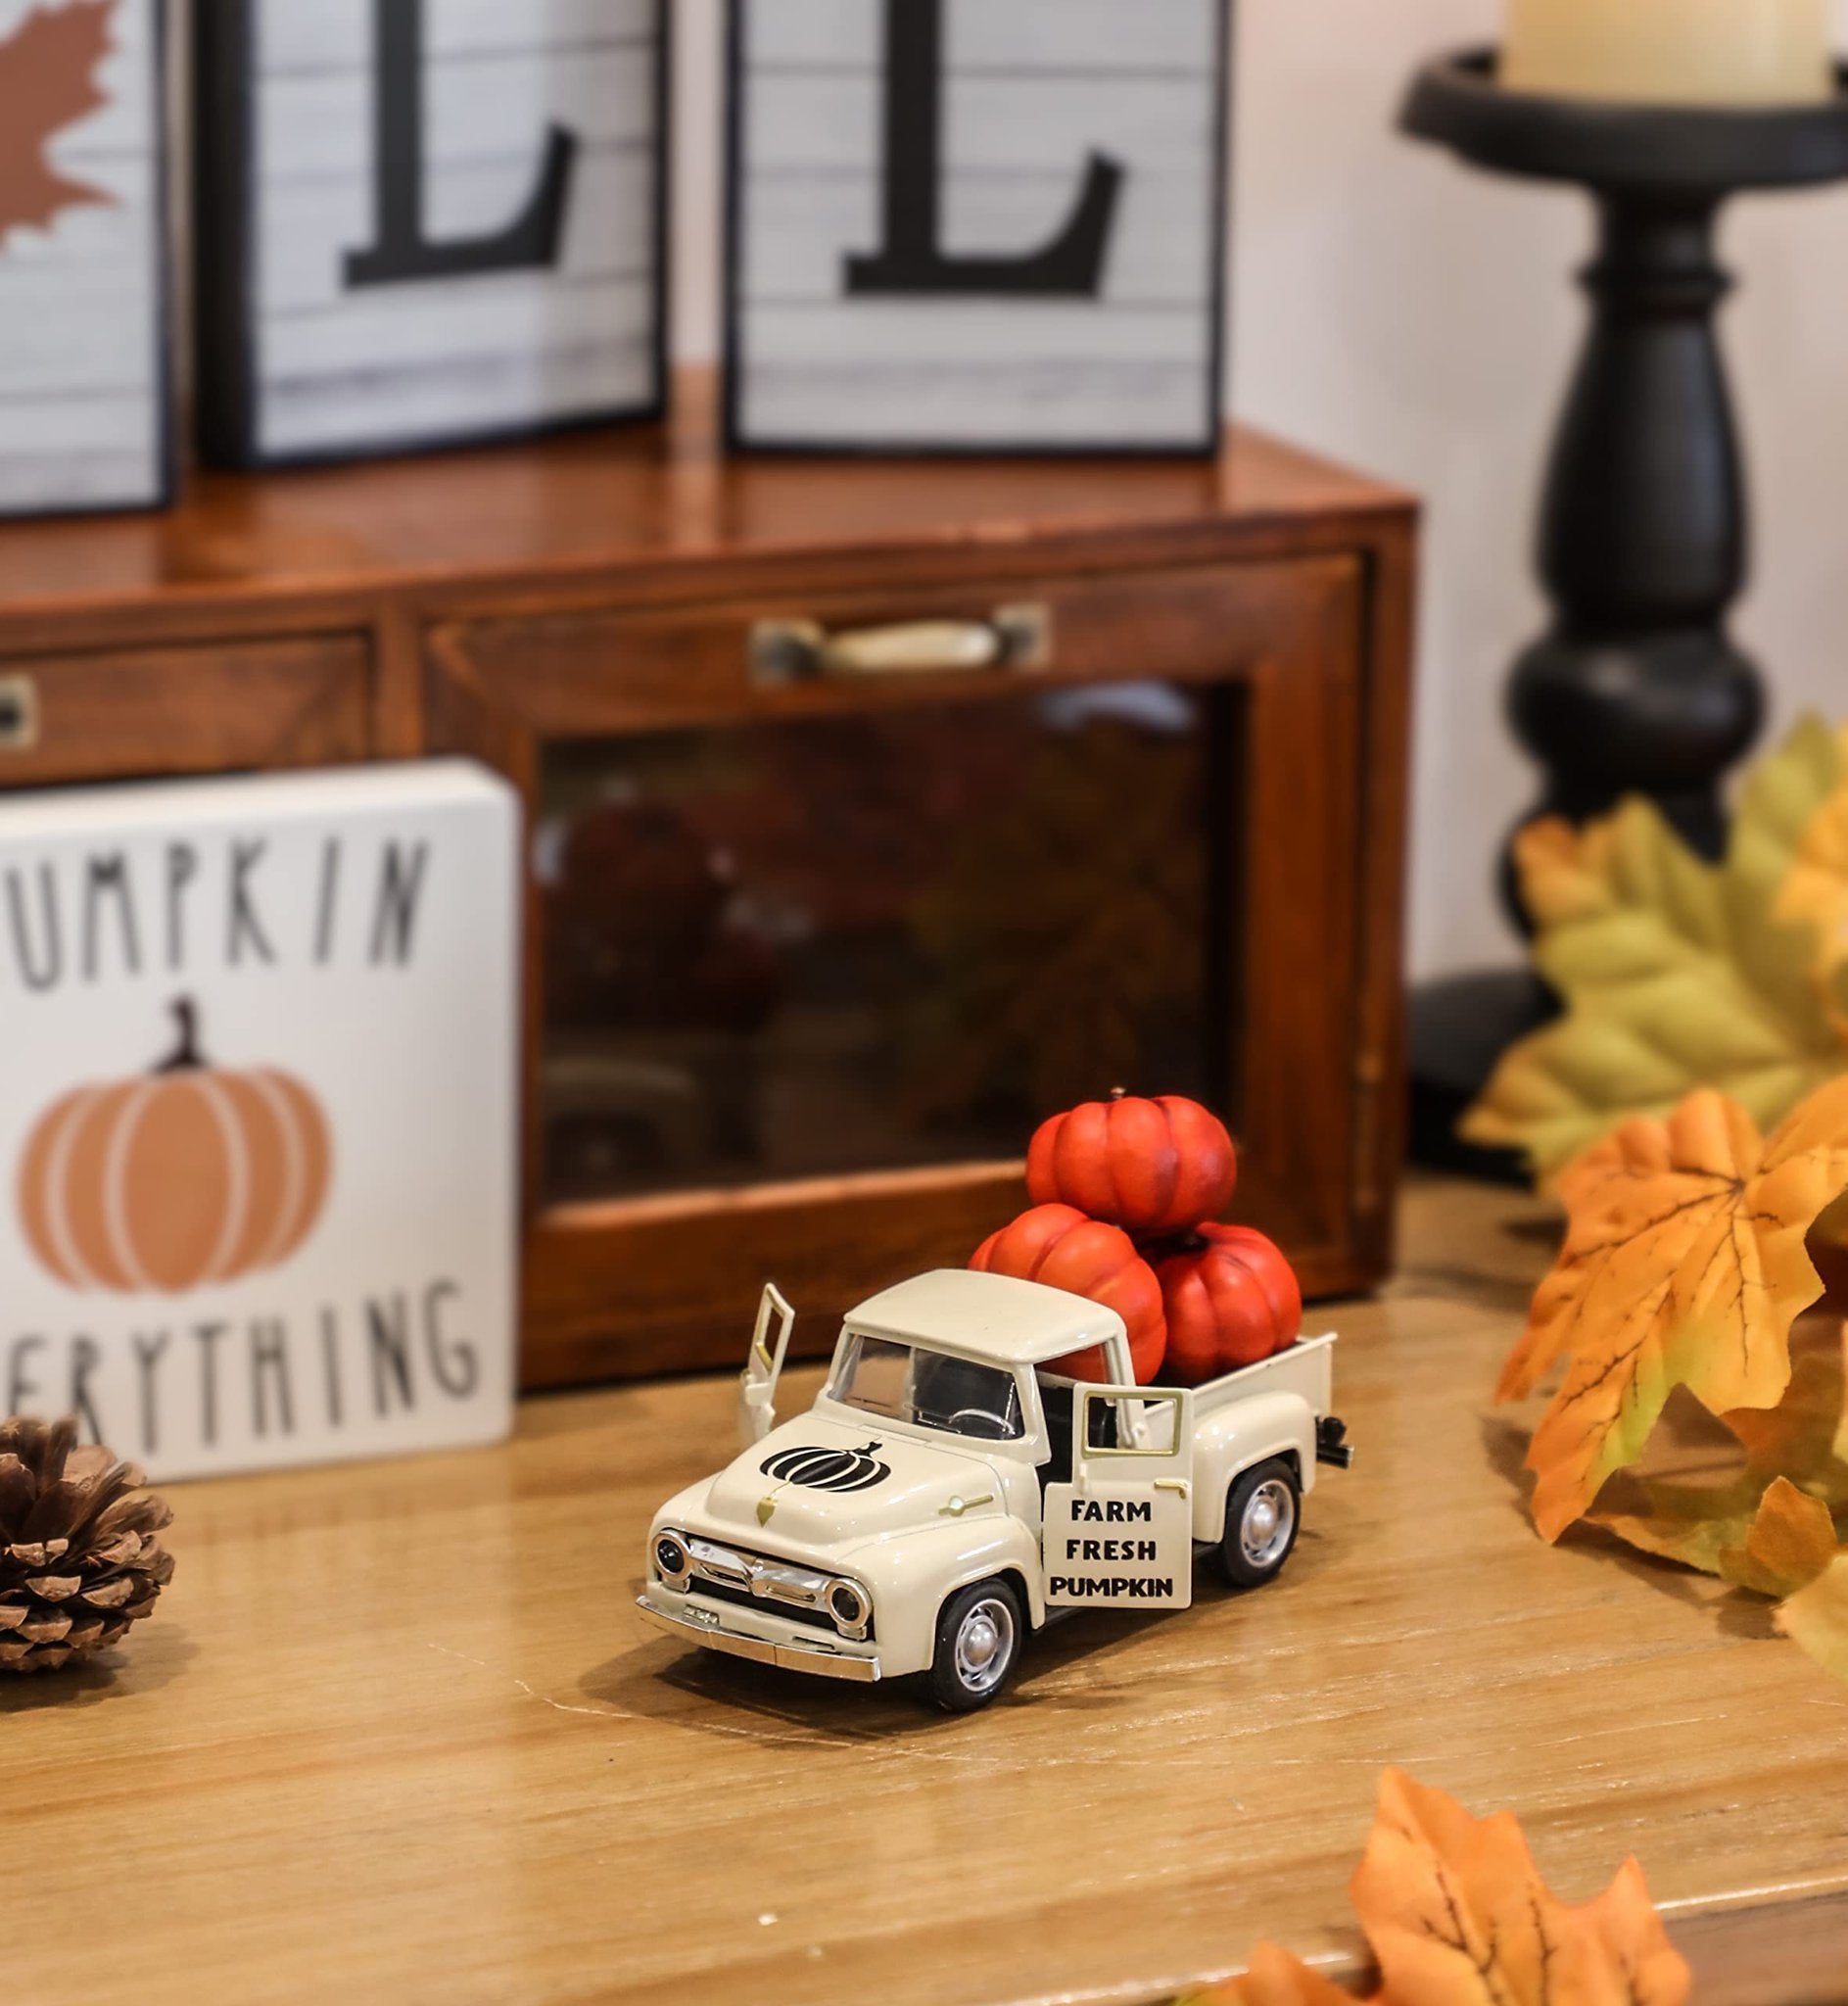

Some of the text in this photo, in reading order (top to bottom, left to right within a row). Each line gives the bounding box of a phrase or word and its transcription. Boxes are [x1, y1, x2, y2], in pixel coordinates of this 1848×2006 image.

[5, 836, 429, 992] UMPKIN
[1071, 1500, 1152, 1522] FARM
[1066, 1539, 1157, 1561] FRESH
[1050, 1576, 1173, 1598] PUMPKIN
